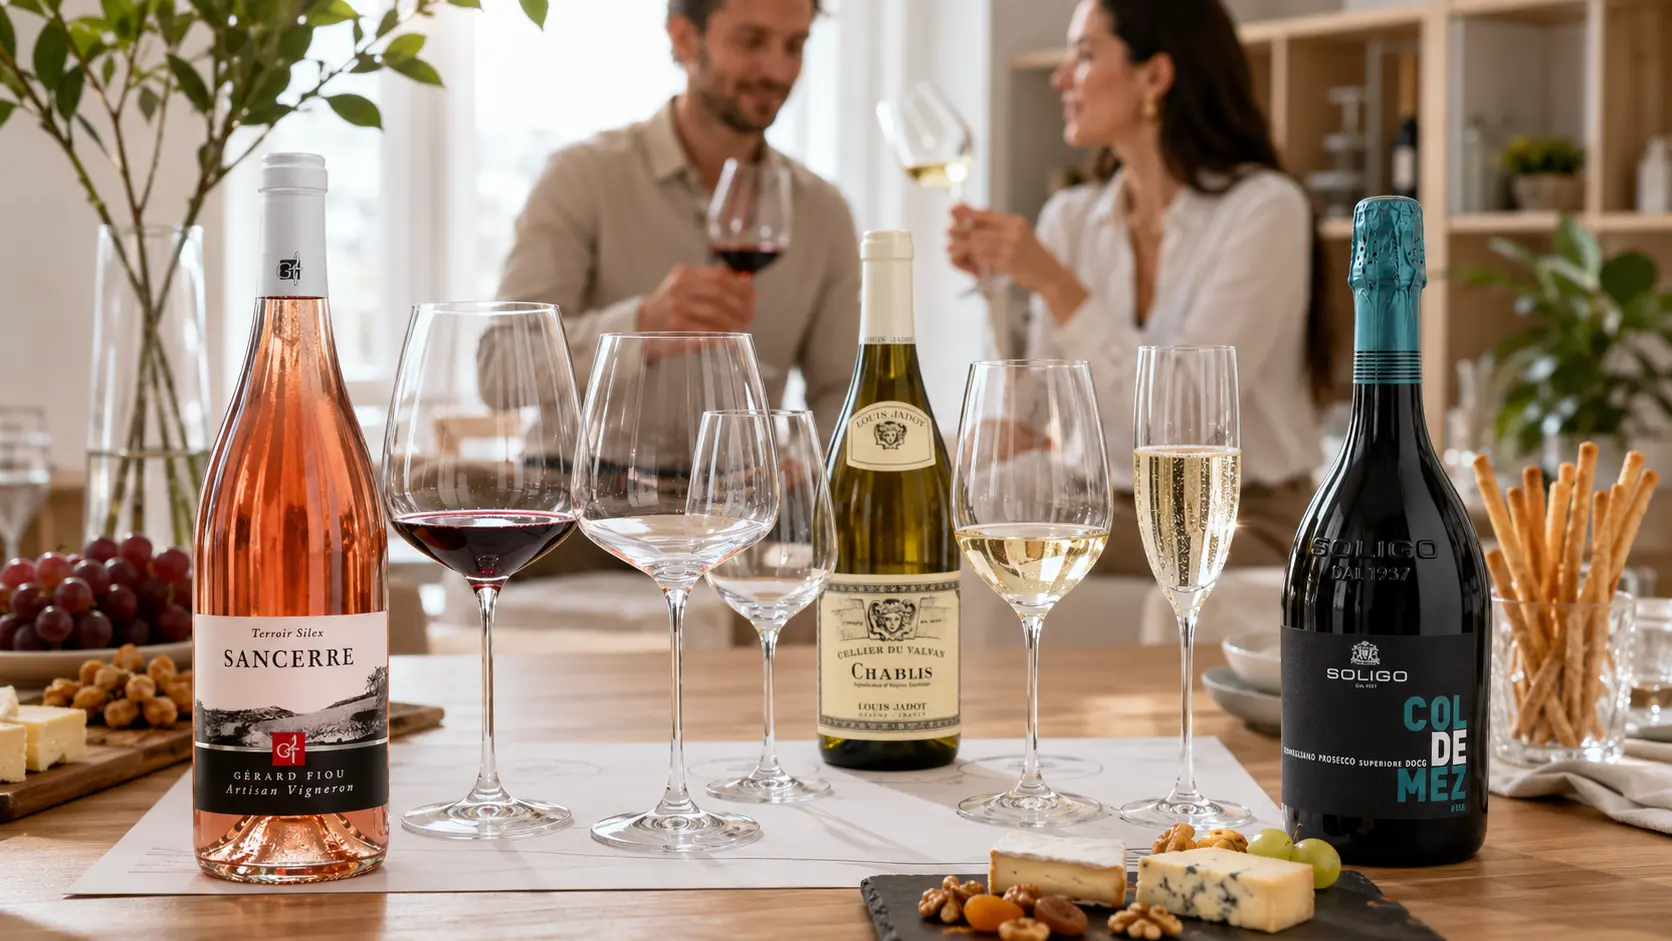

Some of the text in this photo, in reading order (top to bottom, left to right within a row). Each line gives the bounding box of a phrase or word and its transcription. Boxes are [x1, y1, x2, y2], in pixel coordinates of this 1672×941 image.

[856, 411, 925, 428] LOUIS JADOT
[1311, 537, 1438, 559] SOLIGO
[1331, 565, 1410, 580] DAL 1937
[252, 628, 324, 638] Terroir Silex
[224, 648, 354, 668] SANCERRE
[837, 645, 945, 660] CELLIER DU VALVAN
[1327, 668, 1407, 682] SOLIGO
[858, 702, 927, 711] LOUIS JADOT
[1403, 694, 1467, 732] COL
[1431, 729, 1467, 767] DE
[1318, 754, 1356, 766] PROSECCO
[1358, 760, 1402, 768] SUPERIORE
[1405, 759, 1427, 768] DOCG
[233, 769, 345, 781] GÉRARD FIOU
[225, 784, 354, 798] Artisan Vigneron
[1397, 765, 1467, 803] MEZ
